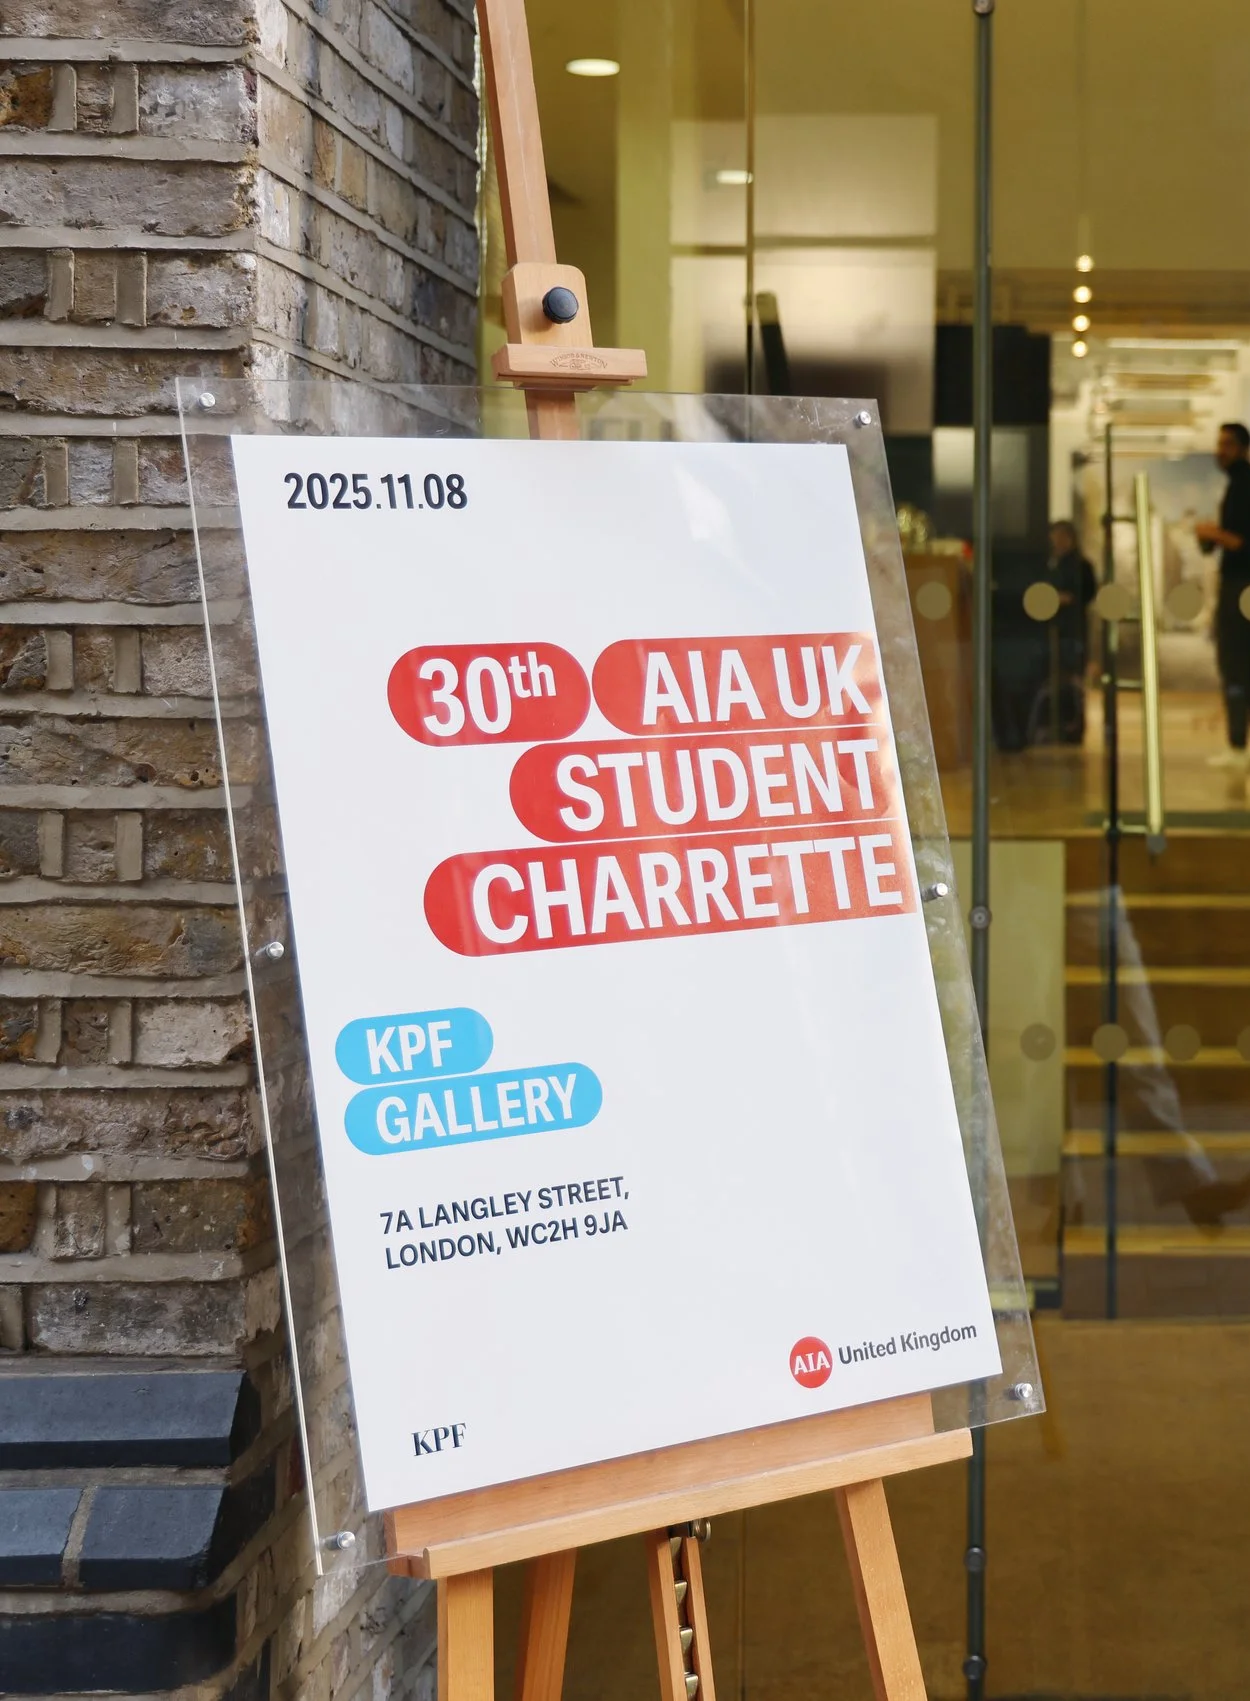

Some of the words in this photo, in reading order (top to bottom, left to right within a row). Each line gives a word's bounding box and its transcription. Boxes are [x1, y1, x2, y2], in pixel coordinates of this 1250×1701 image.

[284, 472, 468, 510] 2025.11.08
[417, 651, 558, 737] 30th
[641, 649, 765, 726] AIA
[774, 643, 874, 718] UK
[556, 738, 879, 832] STUDENT
[471, 834, 904, 944] CHARRETTE
[365, 1020, 453, 1075] KPF
[375, 1074, 577, 1145] GALLERY
[379, 1209, 413, 1235] 7A
[417, 1190, 533, 1229] LANGLEY
[537, 1176, 630, 1210] STREET,
[385, 1229, 503, 1269] LONDON,
[506, 1219, 579, 1249] WC2H
[583, 1210, 628, 1238] 9JA
[793, 1352, 830, 1375] AIA
[837, 1334, 897, 1365] United
[899, 1322, 978, 1358] Kingdom
[411, 1423, 468, 1457] KPF
